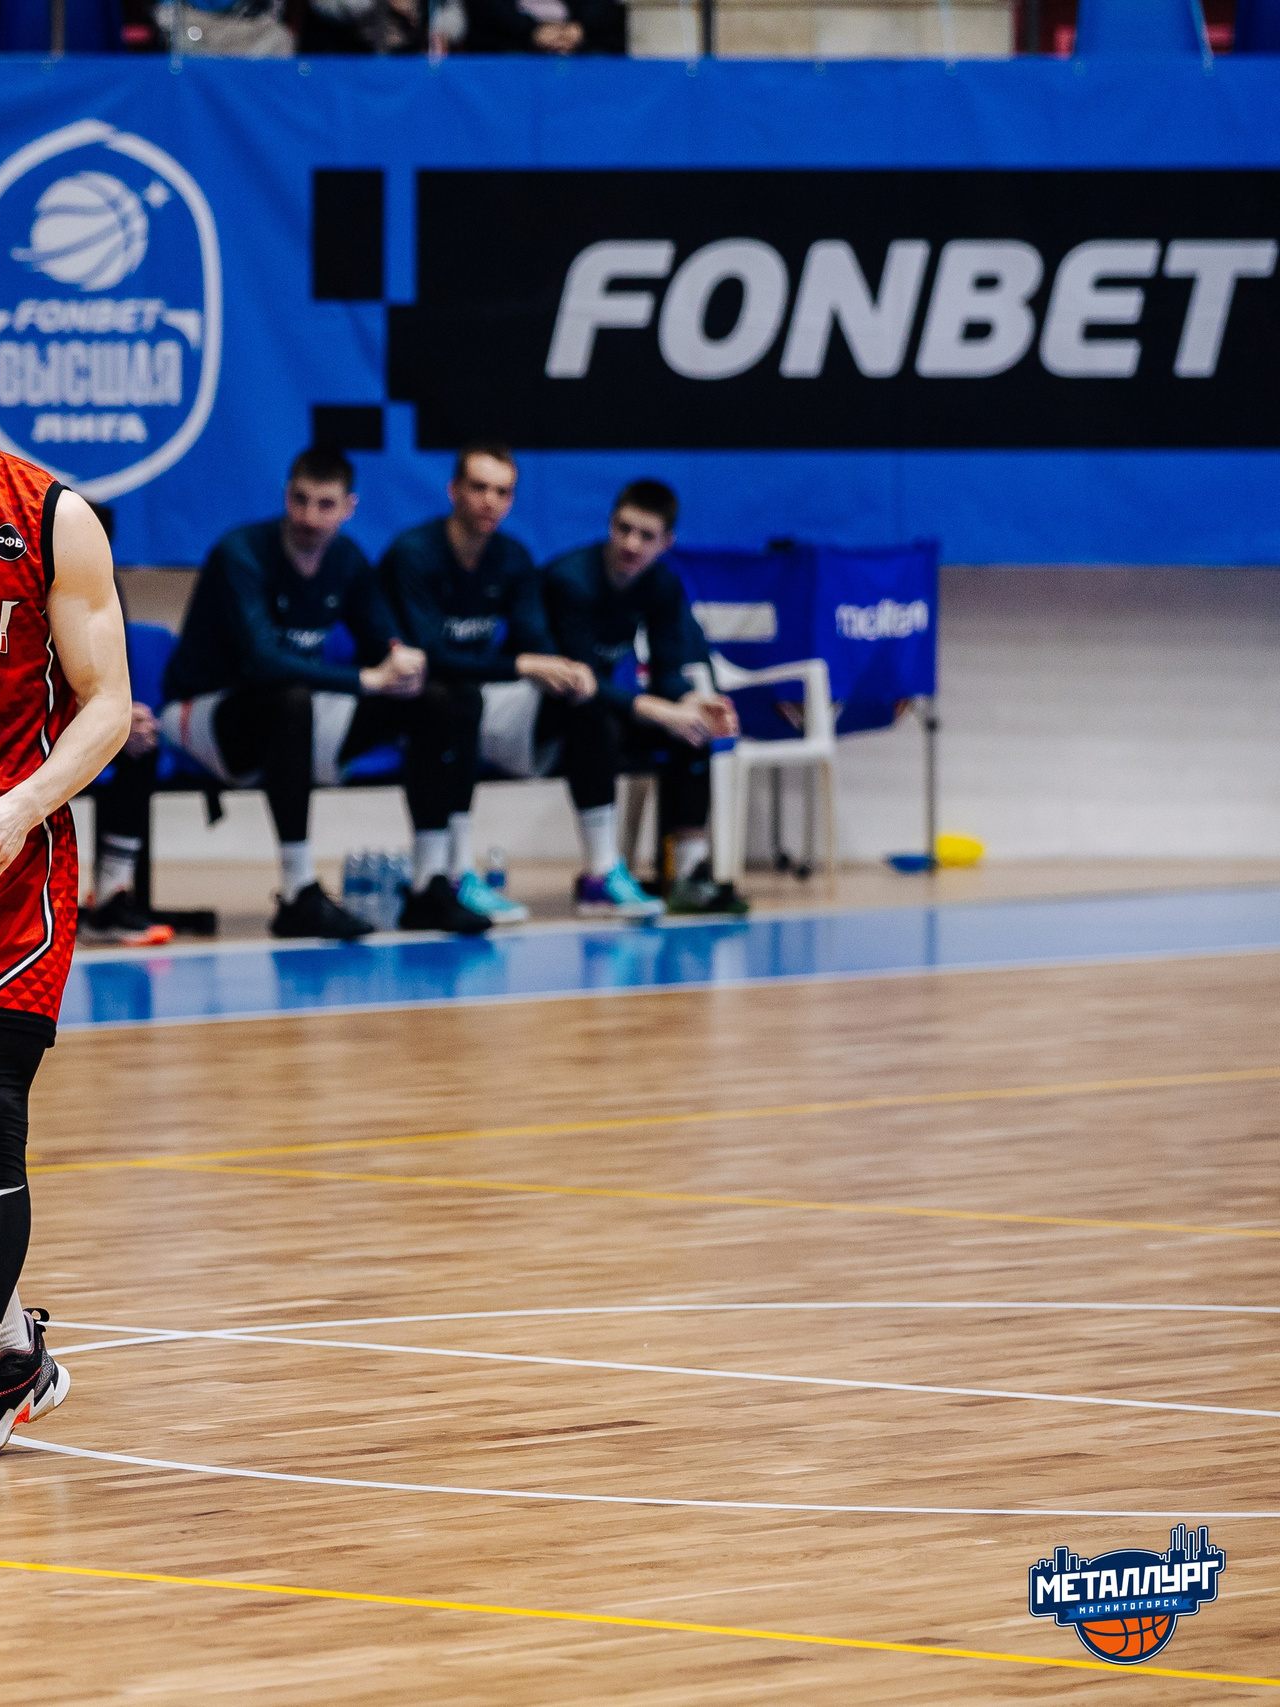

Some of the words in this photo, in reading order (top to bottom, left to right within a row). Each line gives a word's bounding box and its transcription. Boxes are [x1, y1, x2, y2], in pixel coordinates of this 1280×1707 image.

[13, 299, 163, 334] FONBET
[544, 238, 1278, 380] FONBET
[31, 411, 147, 443] ЛИГА
